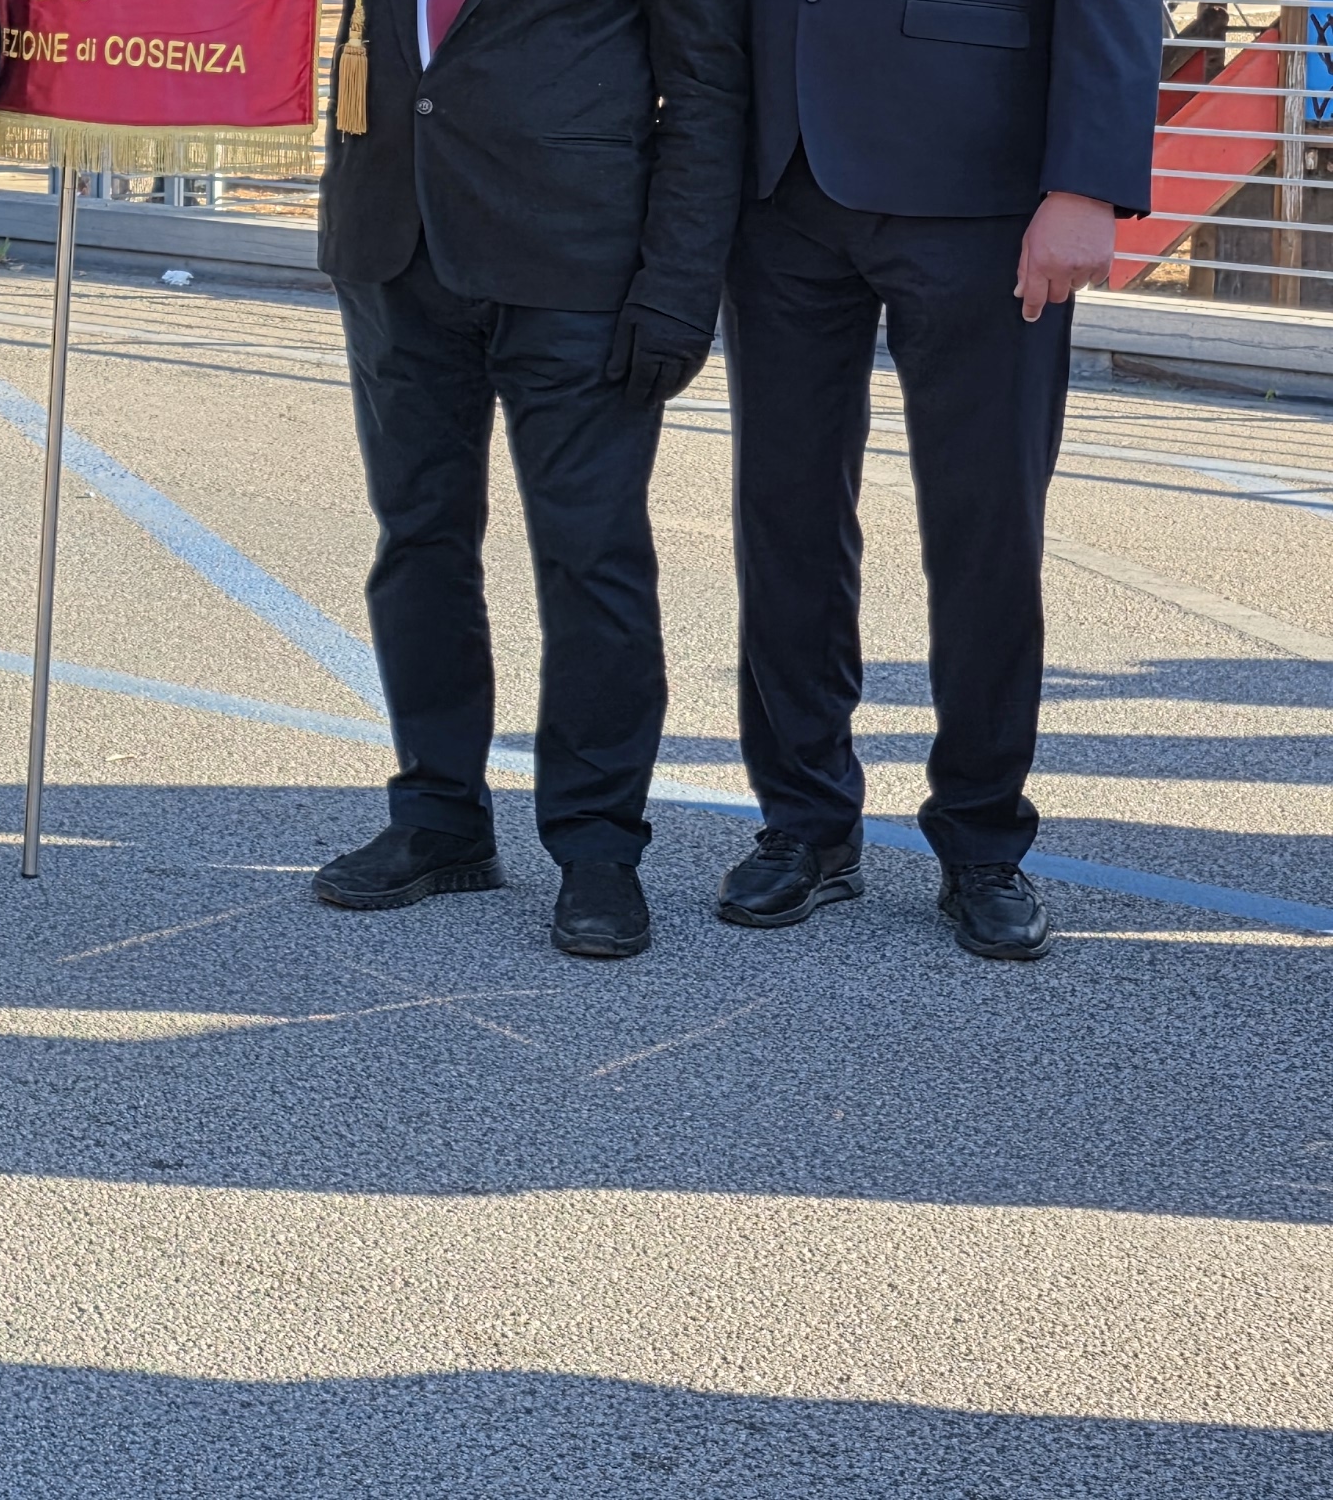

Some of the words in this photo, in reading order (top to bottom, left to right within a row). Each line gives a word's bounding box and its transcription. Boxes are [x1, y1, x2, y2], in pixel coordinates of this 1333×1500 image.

[2, 27, 70, 63] EZIONE
[76, 37, 98, 62] di
[103, 35, 247, 74] COSENZA
